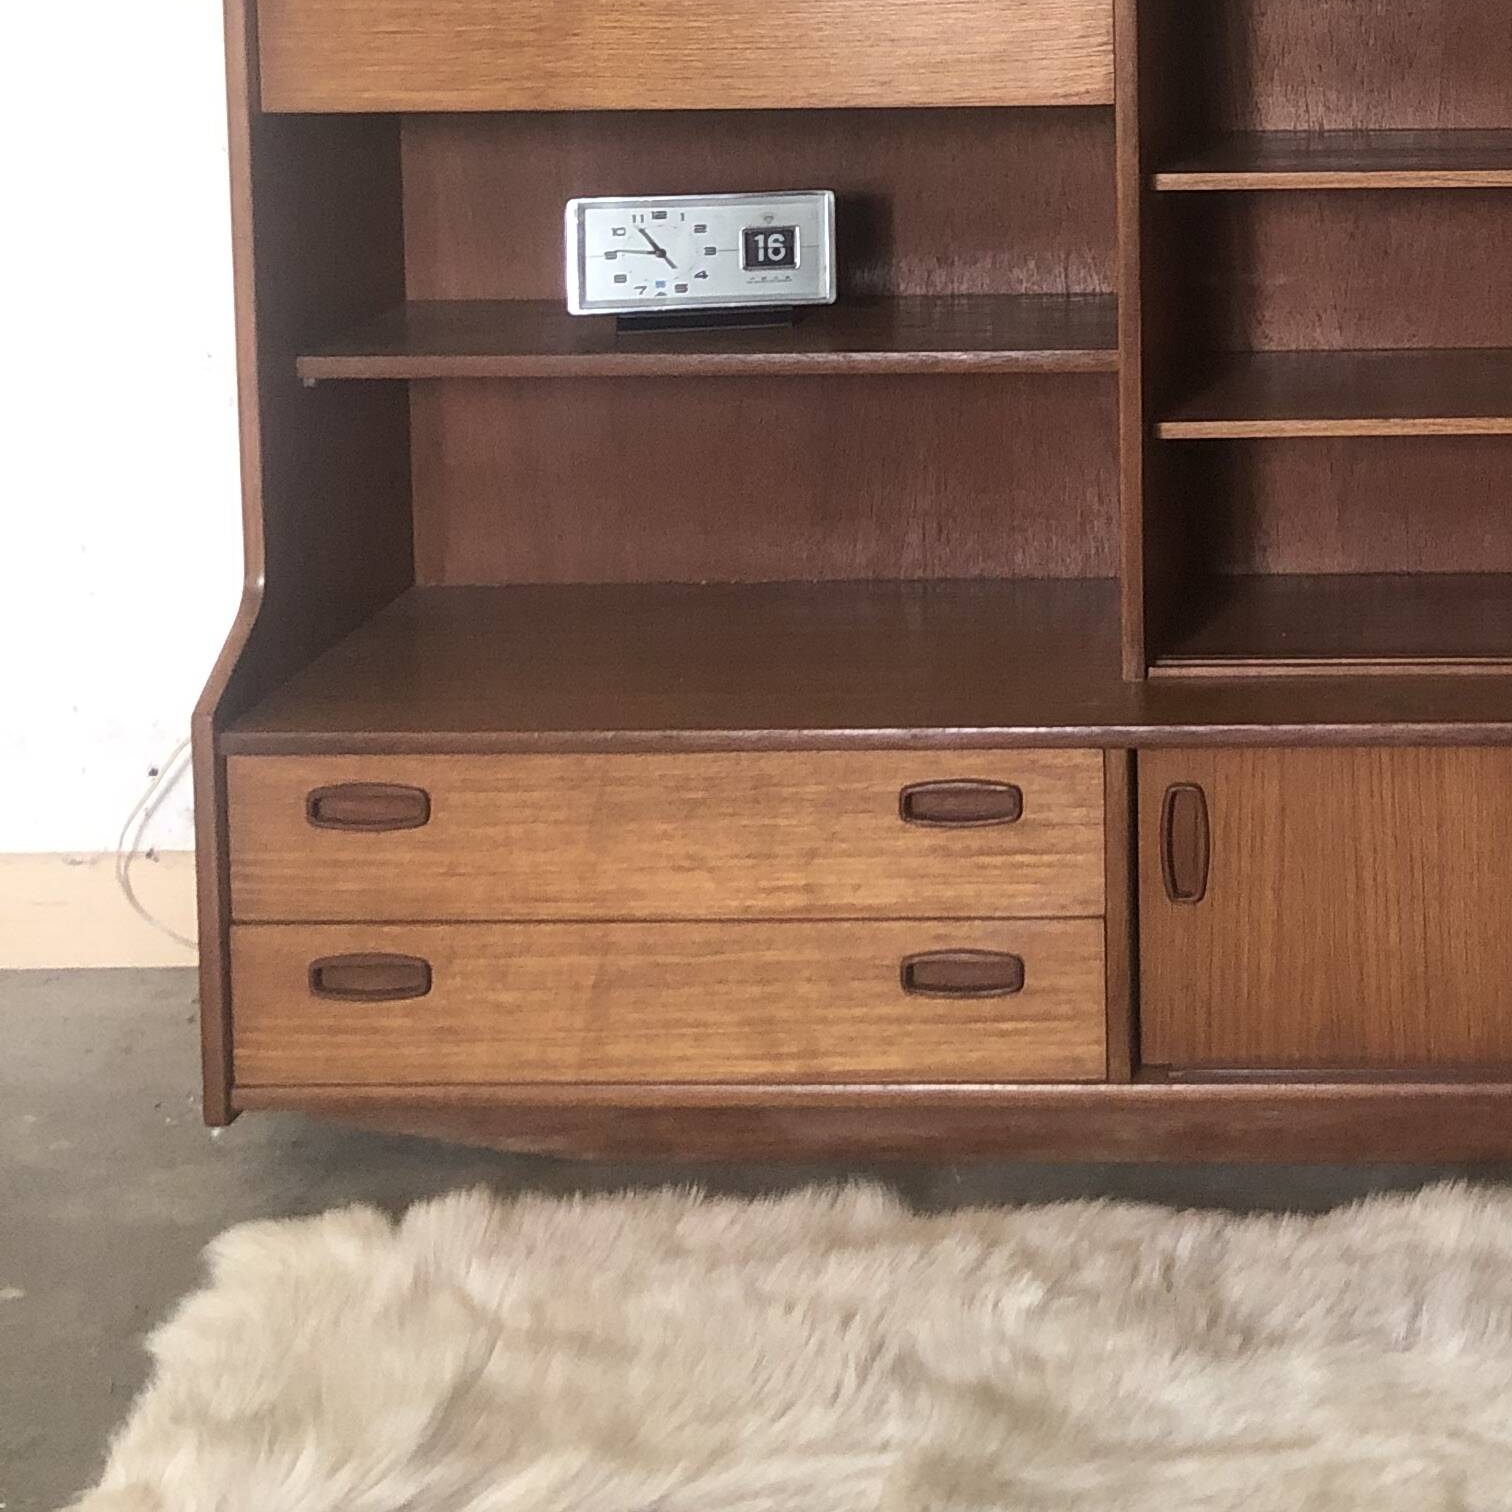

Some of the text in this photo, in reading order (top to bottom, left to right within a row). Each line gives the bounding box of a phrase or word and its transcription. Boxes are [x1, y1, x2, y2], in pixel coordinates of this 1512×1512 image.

[632, 214, 645, 223] 11
[611, 227, 626, 236] 10
[694, 224, 707, 233] 2
[754, 233, 786, 262] 16
[694, 270, 709, 279] 4
[634, 285, 648, 295] 7
